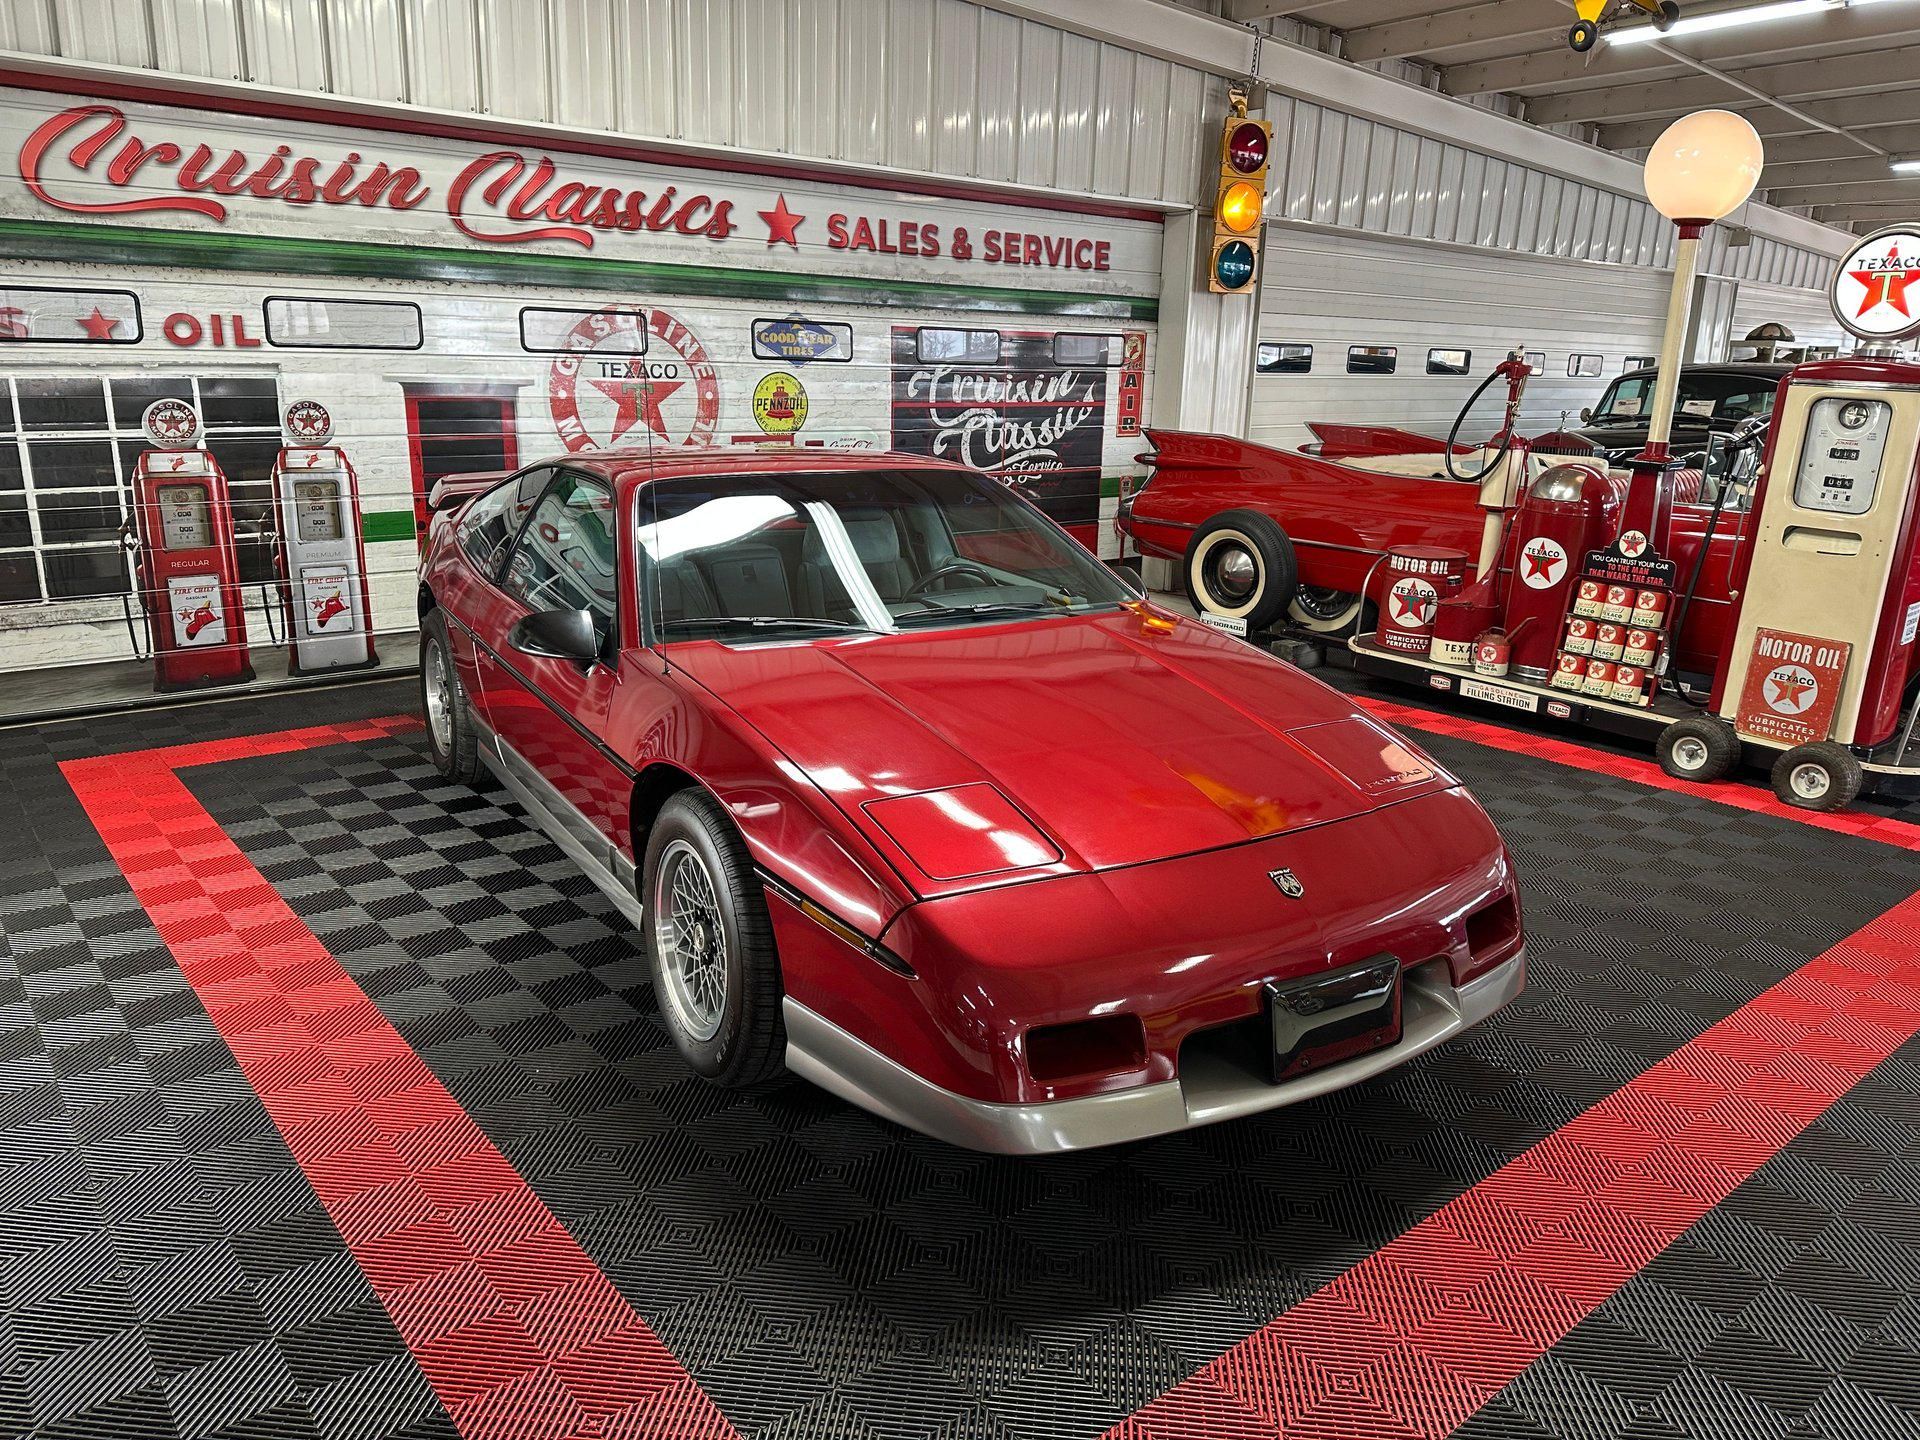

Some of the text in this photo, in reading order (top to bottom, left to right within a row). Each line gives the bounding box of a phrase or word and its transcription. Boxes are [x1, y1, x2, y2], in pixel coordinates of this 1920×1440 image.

[20, 104, 738, 249] Cruisin Classics
[827, 213, 1111, 272] SALES & SERVICE
[163, 312, 261, 347] OIL
[554, 303, 714, 379] GASOLINE
[781, 345, 815, 357] TIRES
[597, 361, 679, 379] TEXACO
[755, 397, 805, 411] PENNZOIL
[907, 367, 1082, 427] Cruisin
[149, 402, 195, 420] GASOLINE
[288, 402, 328, 419] GASOLINE
[305, 551, 342, 559] PREMIUM
[1527, 546, 1560, 558] TEXACO
[171, 559, 210, 568] REGULAR
[1390, 554, 1449, 575] MOTOR OIL
[1591, 554, 1669, 571] YOU CAN TRUST YOUR CAR
[1617, 564, 1630, 573] THE
[1631, 566, 1650, 576] MAN
[1588, 568, 1606, 577] THAT
[1606, 570, 1631, 581] WEARS
[1632, 574, 1645, 583] THE
[1395, 585, 1435, 598] TEXACO
[1385, 633, 1429, 645] LUBRICATES
[1386, 639, 1427, 650] PERFECTLY
[1444, 643, 1479, 654] TEXAC
[1758, 636, 1841, 670] MOTOR OIL
[1431, 678, 1450, 688] TEXACO
[1772, 671, 1815, 687] TEXACO
[1466, 687, 1531, 709] FILLING STATION
[1479, 685, 1520, 698] GASOLINE
[1548, 704, 1569, 715] TEXACO
[1748, 715, 1816, 736] LUBRICATES
[1749, 724, 1811, 742] PERFECTLY
